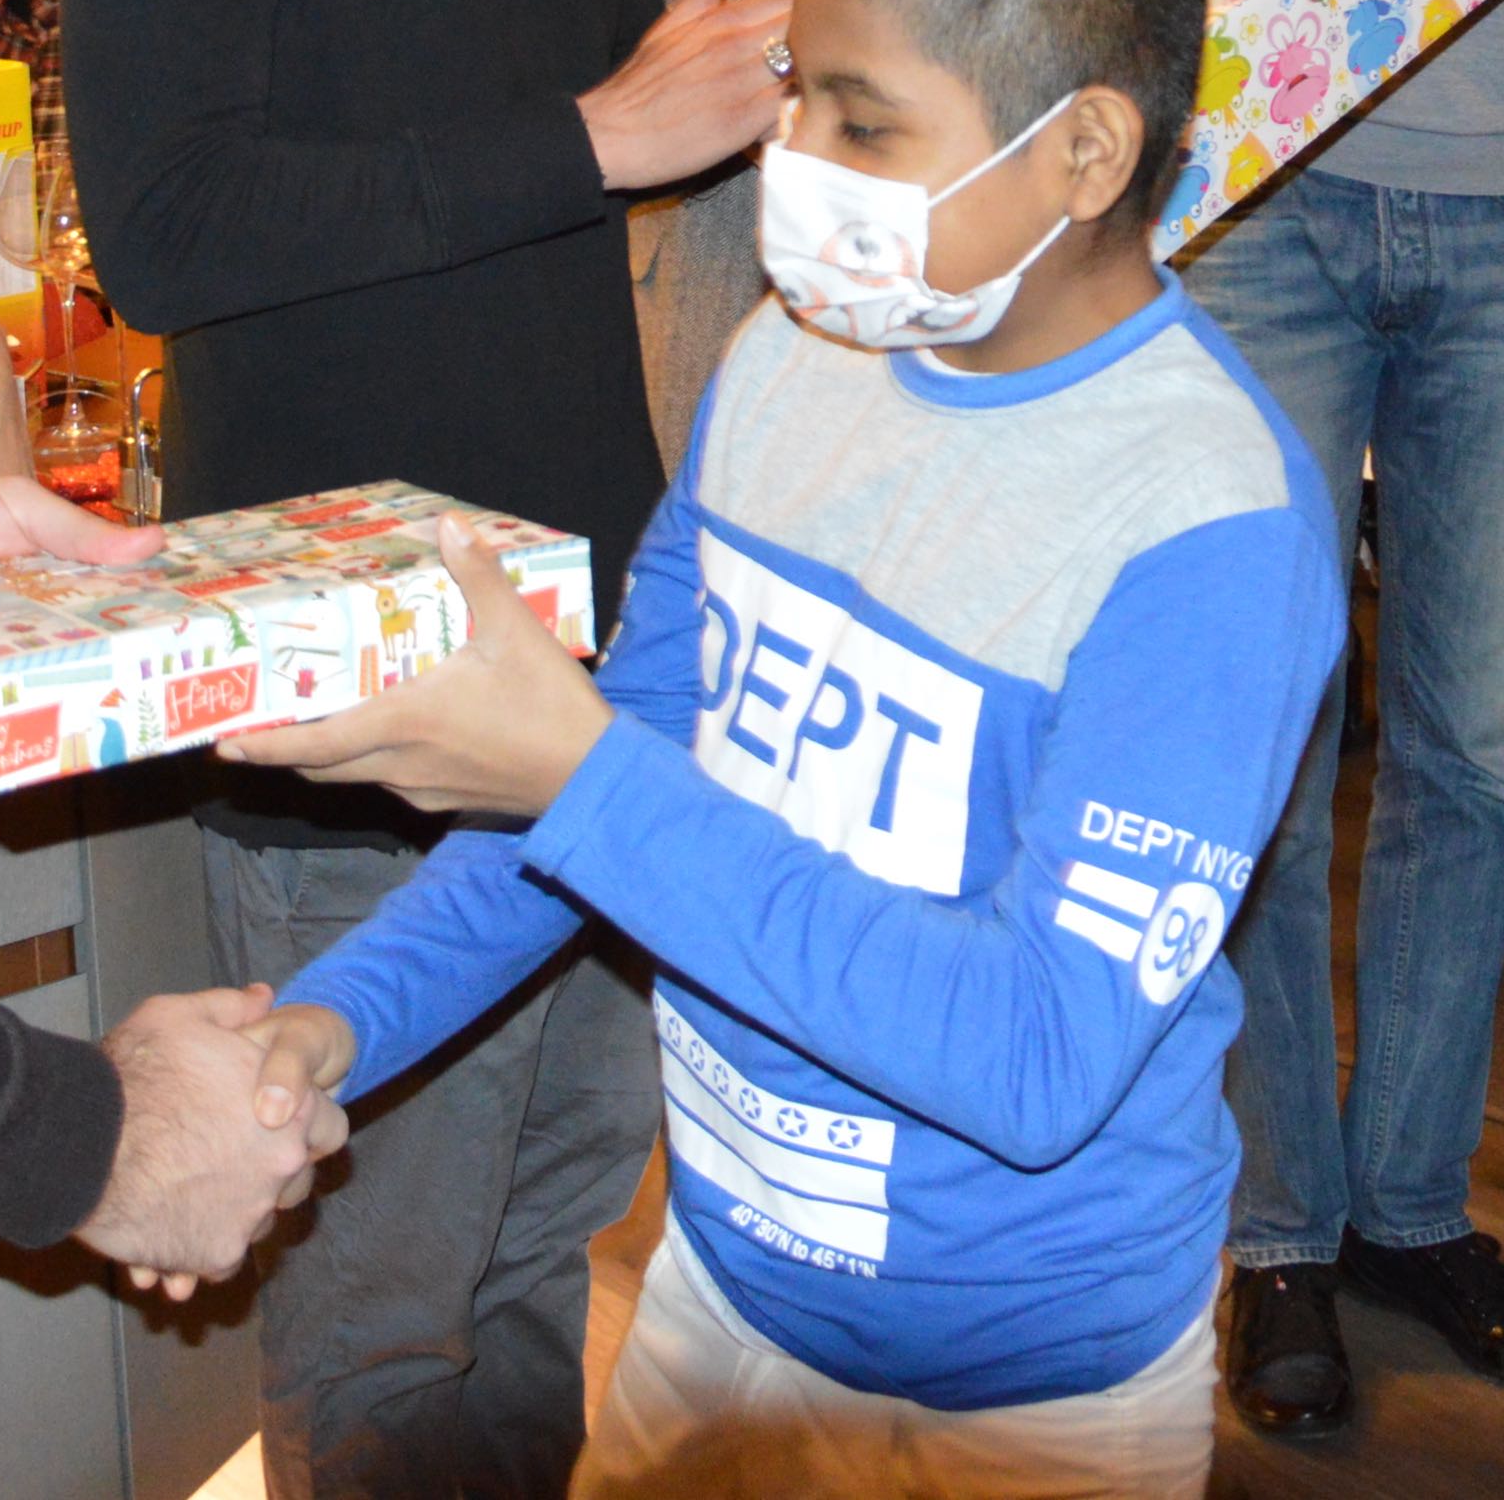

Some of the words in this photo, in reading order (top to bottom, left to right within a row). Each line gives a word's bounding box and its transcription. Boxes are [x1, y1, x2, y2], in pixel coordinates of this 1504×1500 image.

[699, 588, 943, 834] DEPT
[1079, 800, 1196, 867] DEPT
[1153, 905, 1209, 979] 98
[792, 1238, 809, 1261] to
